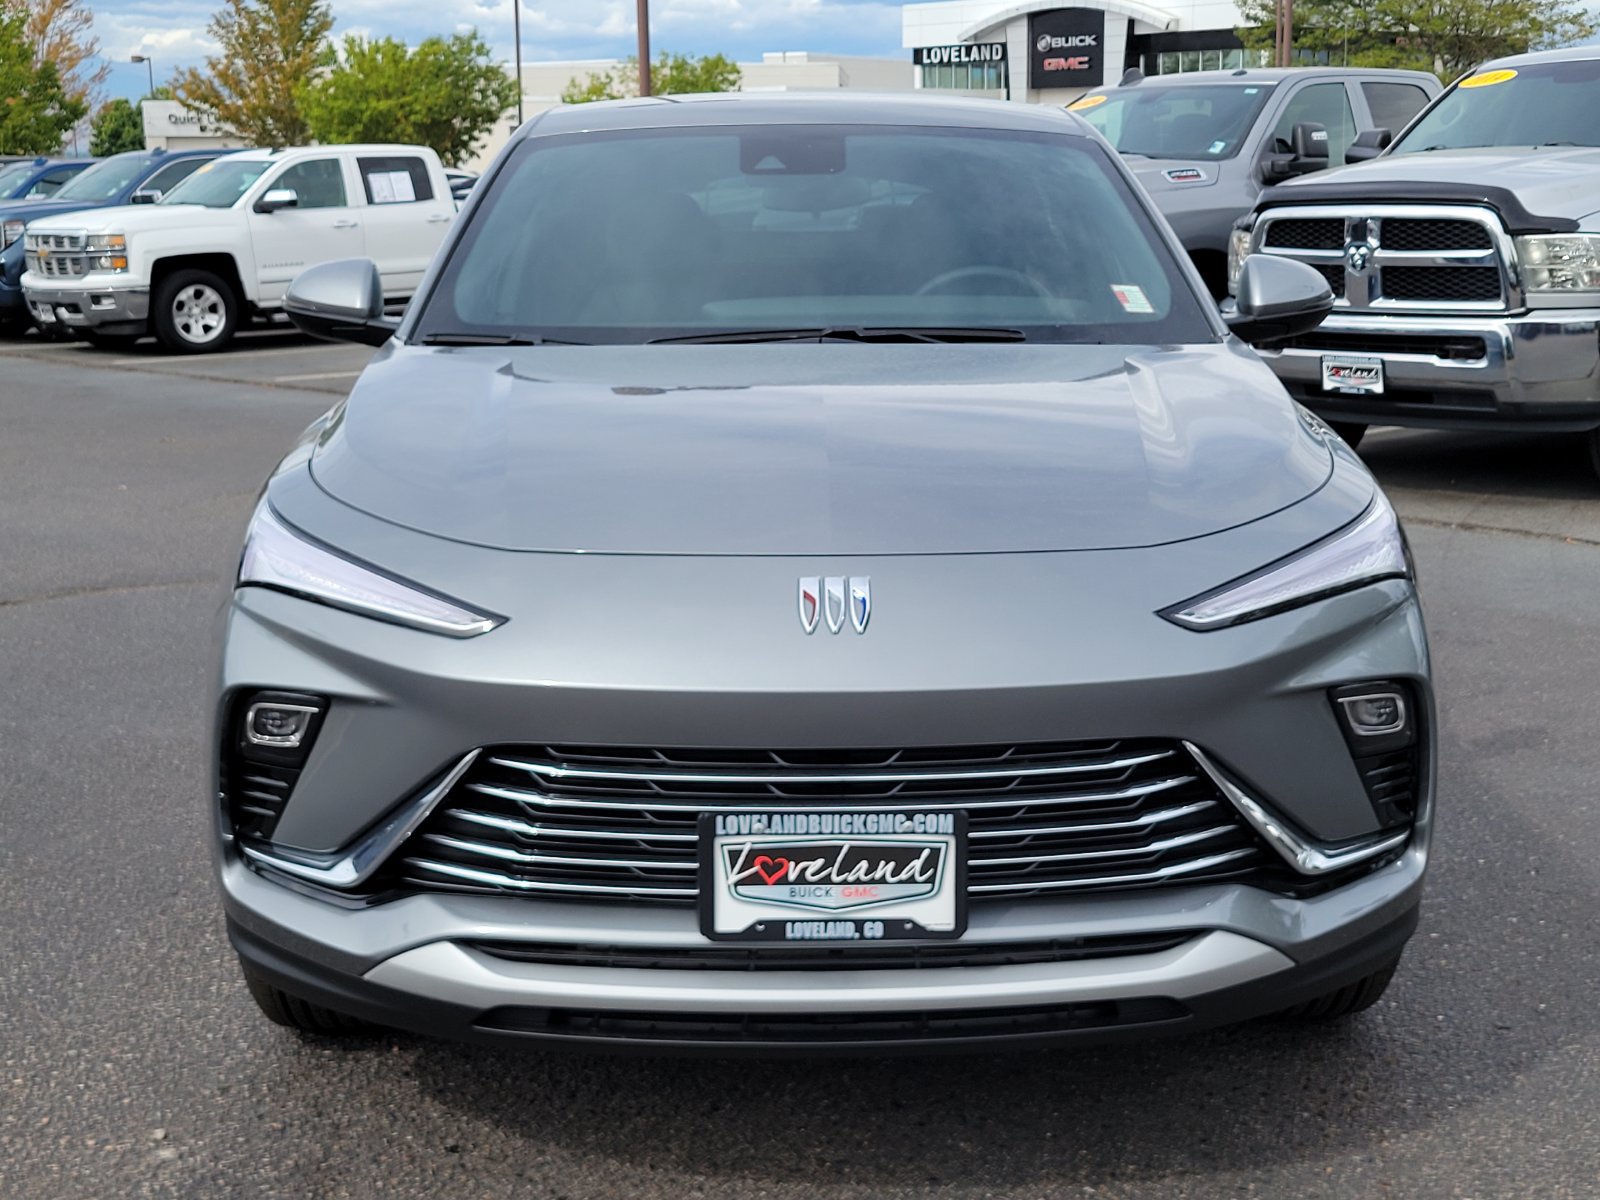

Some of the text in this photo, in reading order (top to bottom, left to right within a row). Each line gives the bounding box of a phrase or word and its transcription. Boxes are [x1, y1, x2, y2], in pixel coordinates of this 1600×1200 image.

[1051, 34, 1097, 48] BUICK
[922, 44, 1003, 64] LOVELAND
[1043, 56, 1089, 70] GMC
[715, 814, 953, 835] LOVELANDBUICKGMCCOM
[727, 842, 934, 886] Loveland
[789, 887, 879, 898] BUICK GMC
[785, 921, 885, 939] LOVELAND, CO
